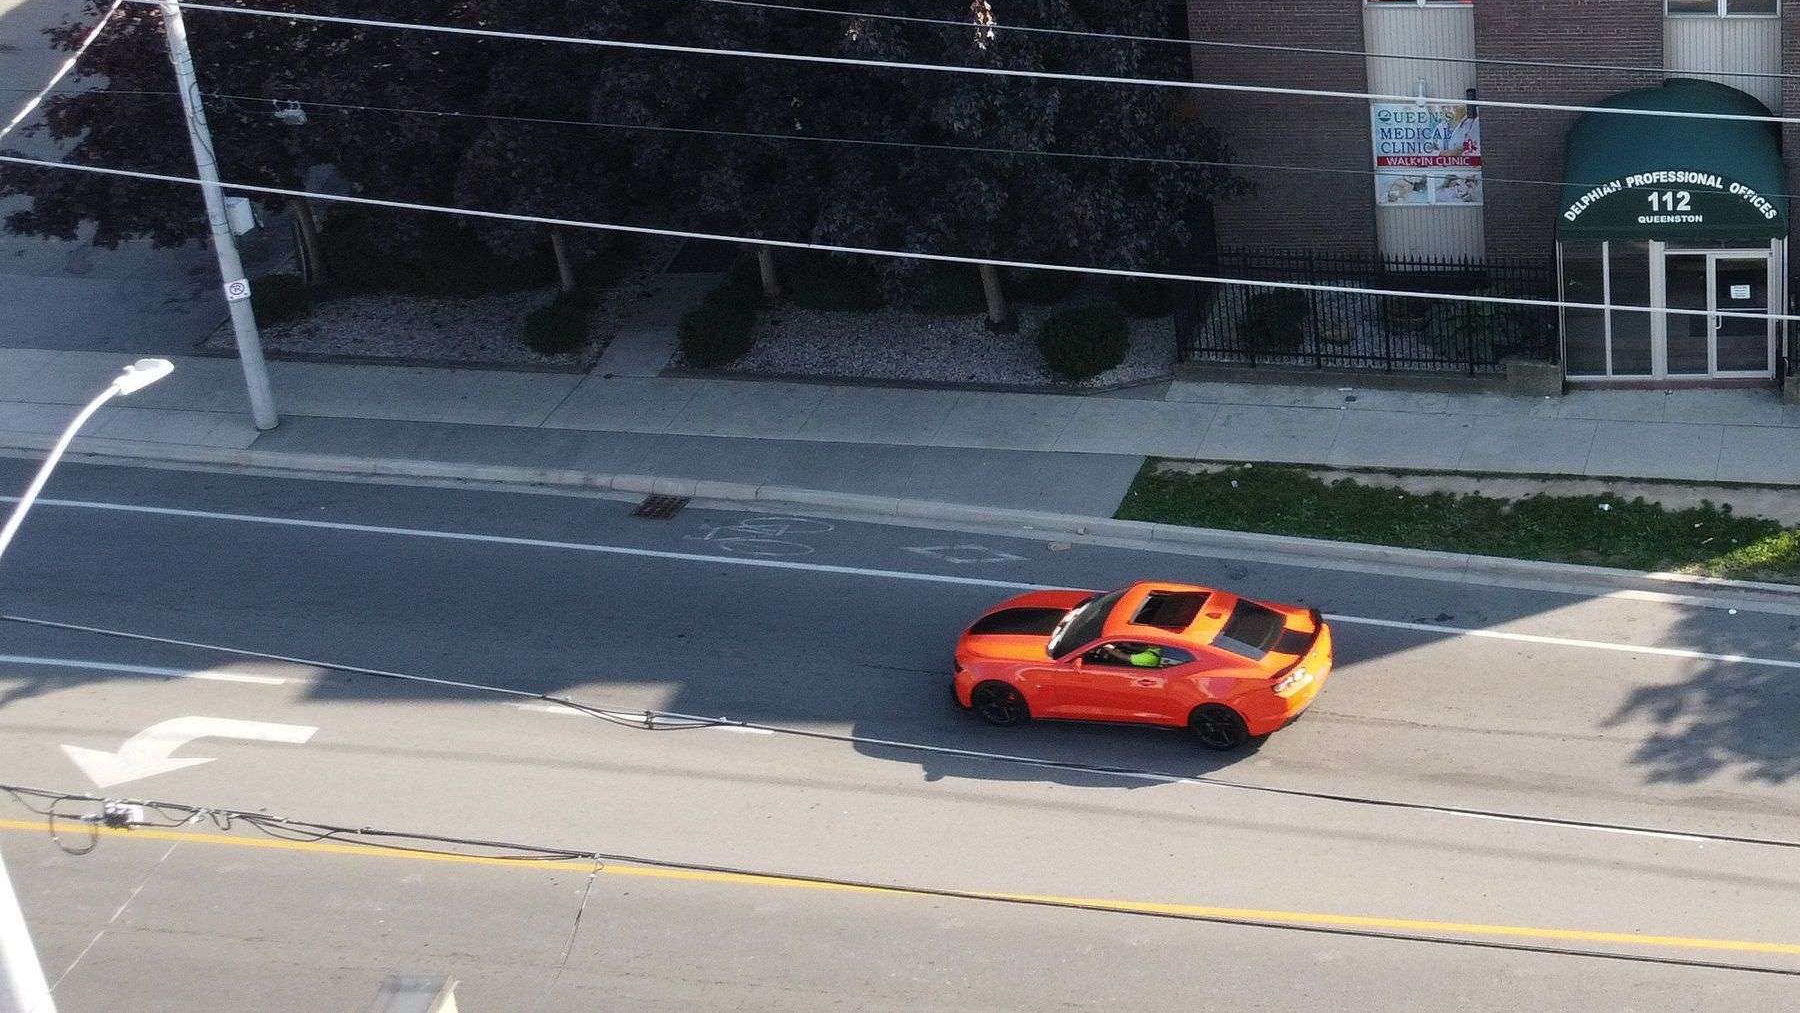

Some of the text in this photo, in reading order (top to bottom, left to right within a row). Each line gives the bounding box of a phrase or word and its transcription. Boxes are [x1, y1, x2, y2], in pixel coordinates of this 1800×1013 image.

[1378, 110, 1454, 124] QUEEN'S
[1380, 128, 1453, 140] MEDICAL
[1380, 142, 1433, 154] CLINIC
[1436, 157, 1470, 165] CLINIC
[1564, 171, 1778, 222] DELPHIAN PROFESSIONAL OFFICES
[1648, 191, 1691, 211] 112
[1638, 215, 1703, 224] QUEENSTON
